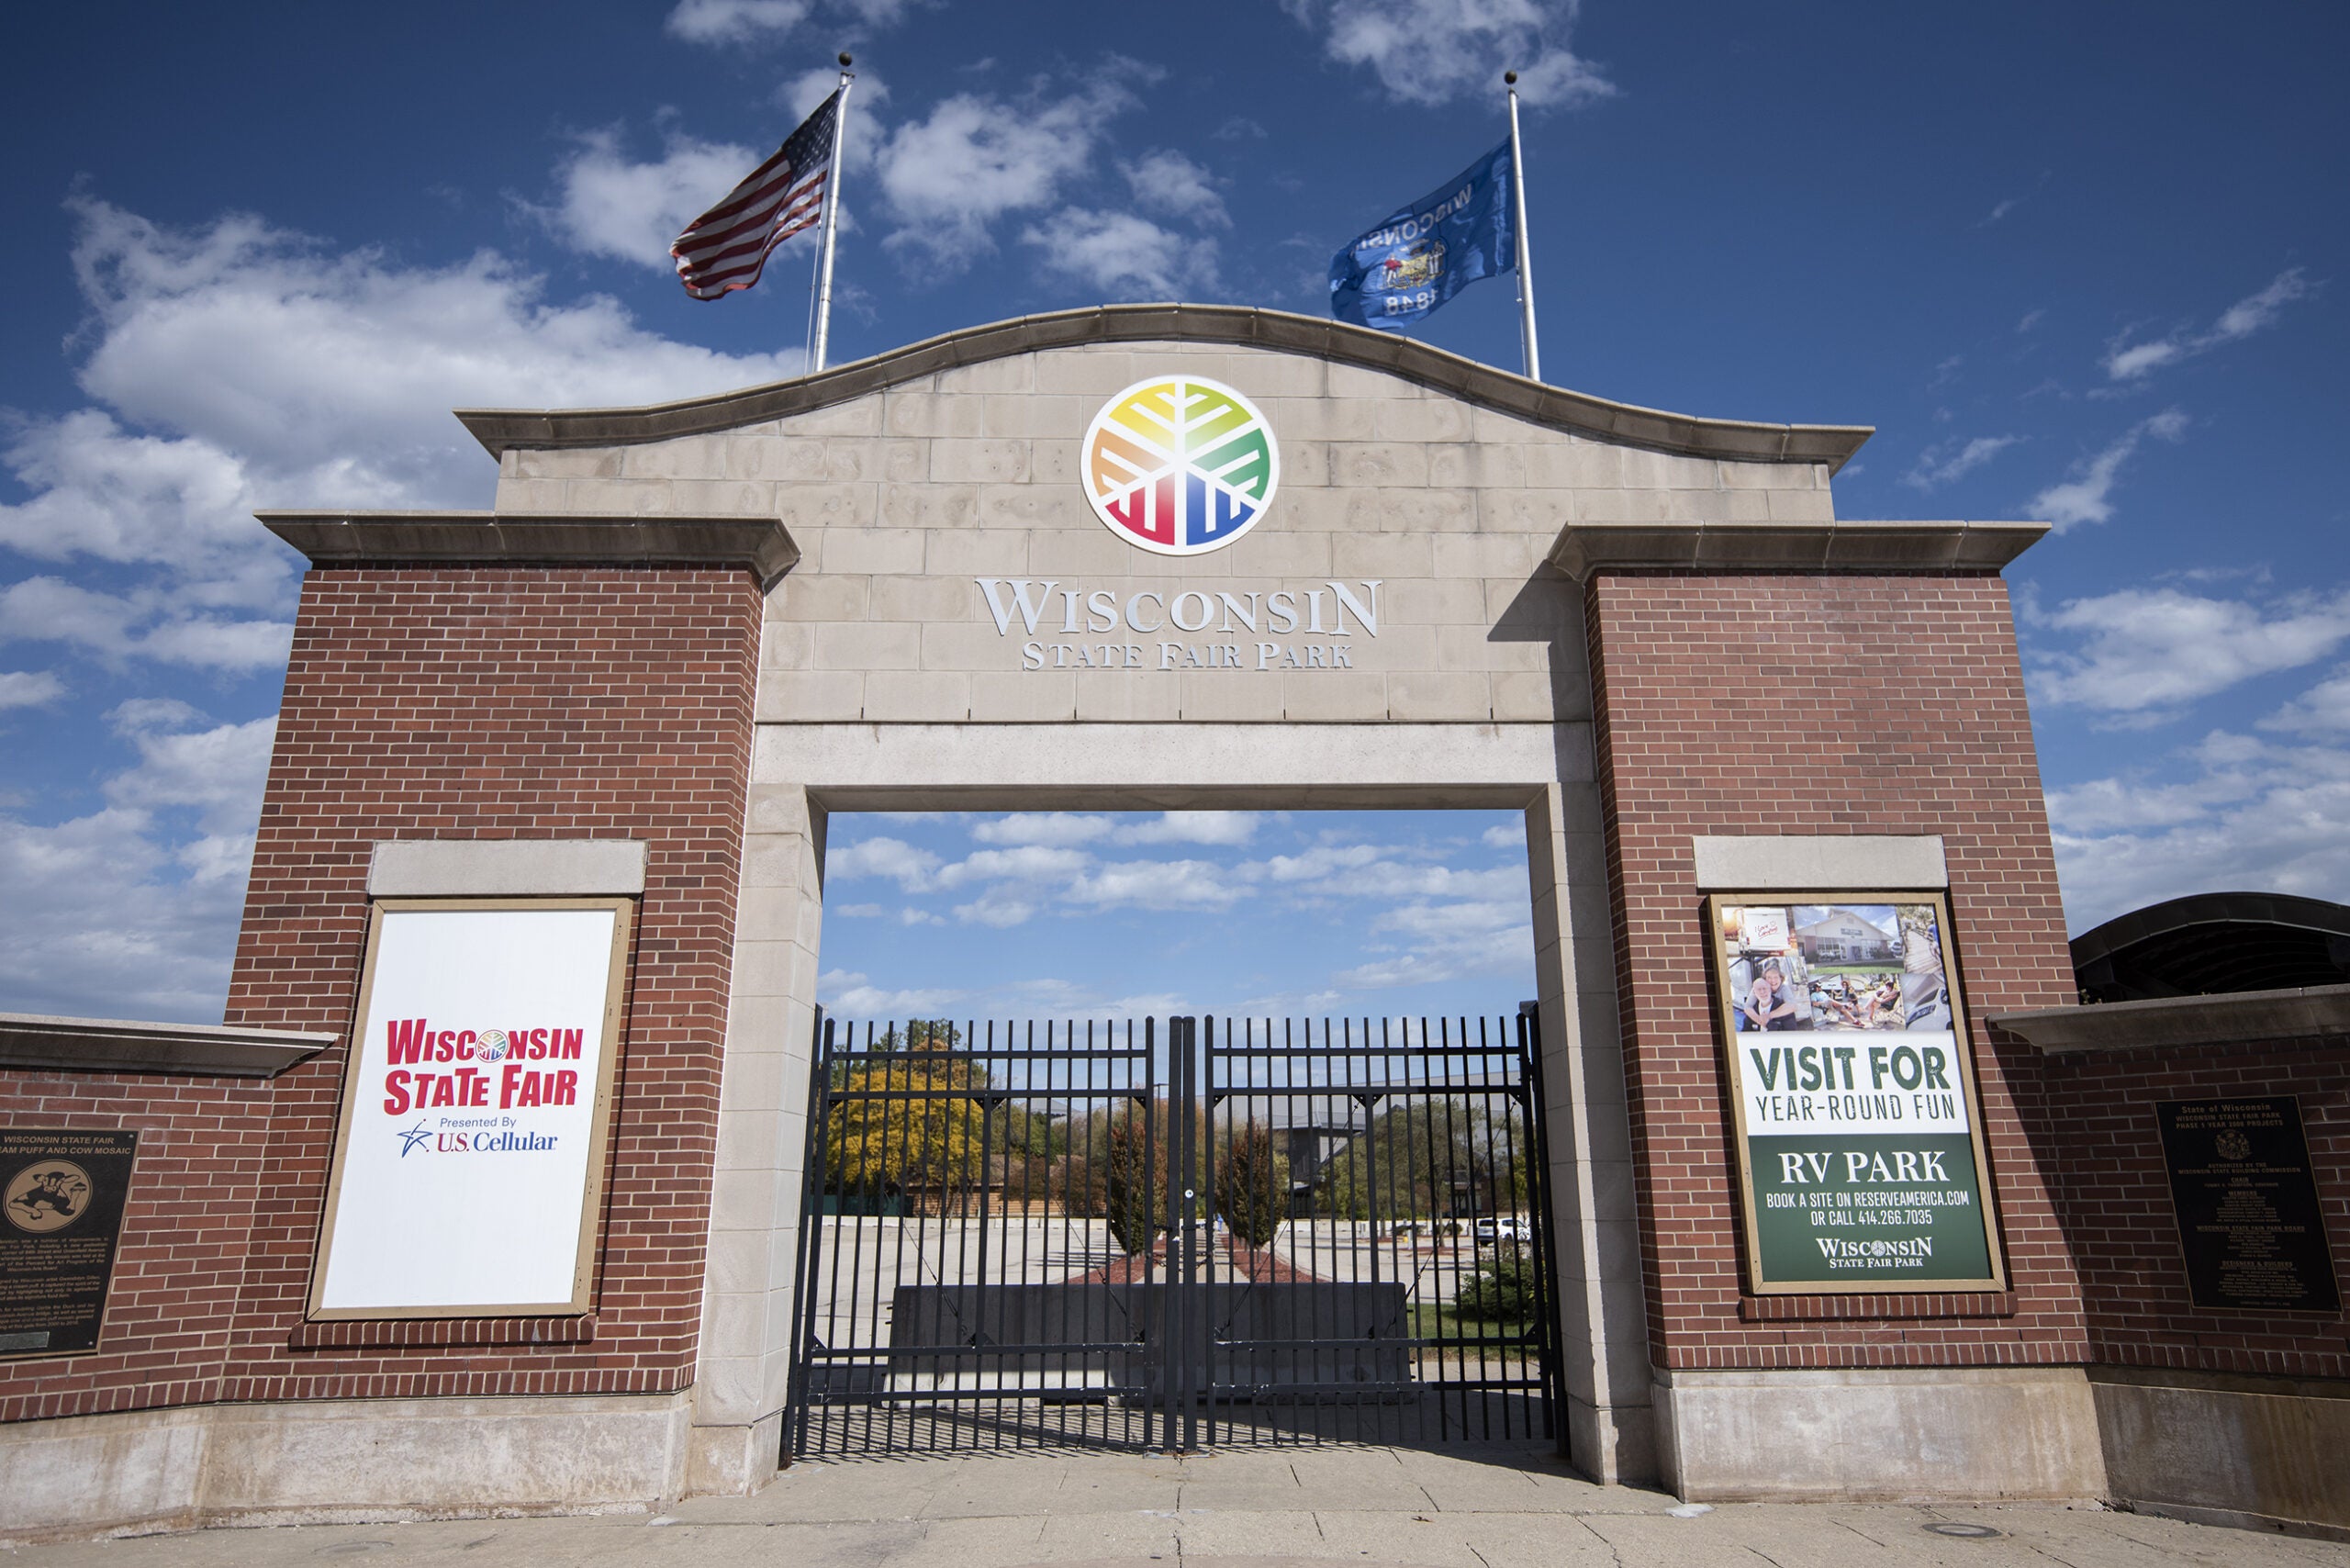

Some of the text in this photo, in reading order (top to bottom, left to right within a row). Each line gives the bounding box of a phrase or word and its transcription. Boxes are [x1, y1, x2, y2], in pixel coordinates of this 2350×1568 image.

[975, 578, 1382, 637] WISCONSIN
[1023, 643, 1353, 671] STATE FAIR PARK
[1750, 1046, 1951, 1092] VISIT FOR
[384, 1064, 577, 1115] STATE FAIR
[1756, 1093, 1955, 1122] YEAR-ROUND FUN
[440, 1116, 517, 1128] Presented By
[4, 1136, 60, 1144] WISCONSIN
[62, 1137, 91, 1145] STATE
[1778, 1151, 1950, 1184] RV PARK
[1767, 1190, 1970, 1208] BOOK A SITE ON RESERVEAMERICA.COM
[1810, 1209, 1932, 1226] OR CALL 414.266.7035
[1830, 1257, 1924, 1269] STATE FAIR PARK
